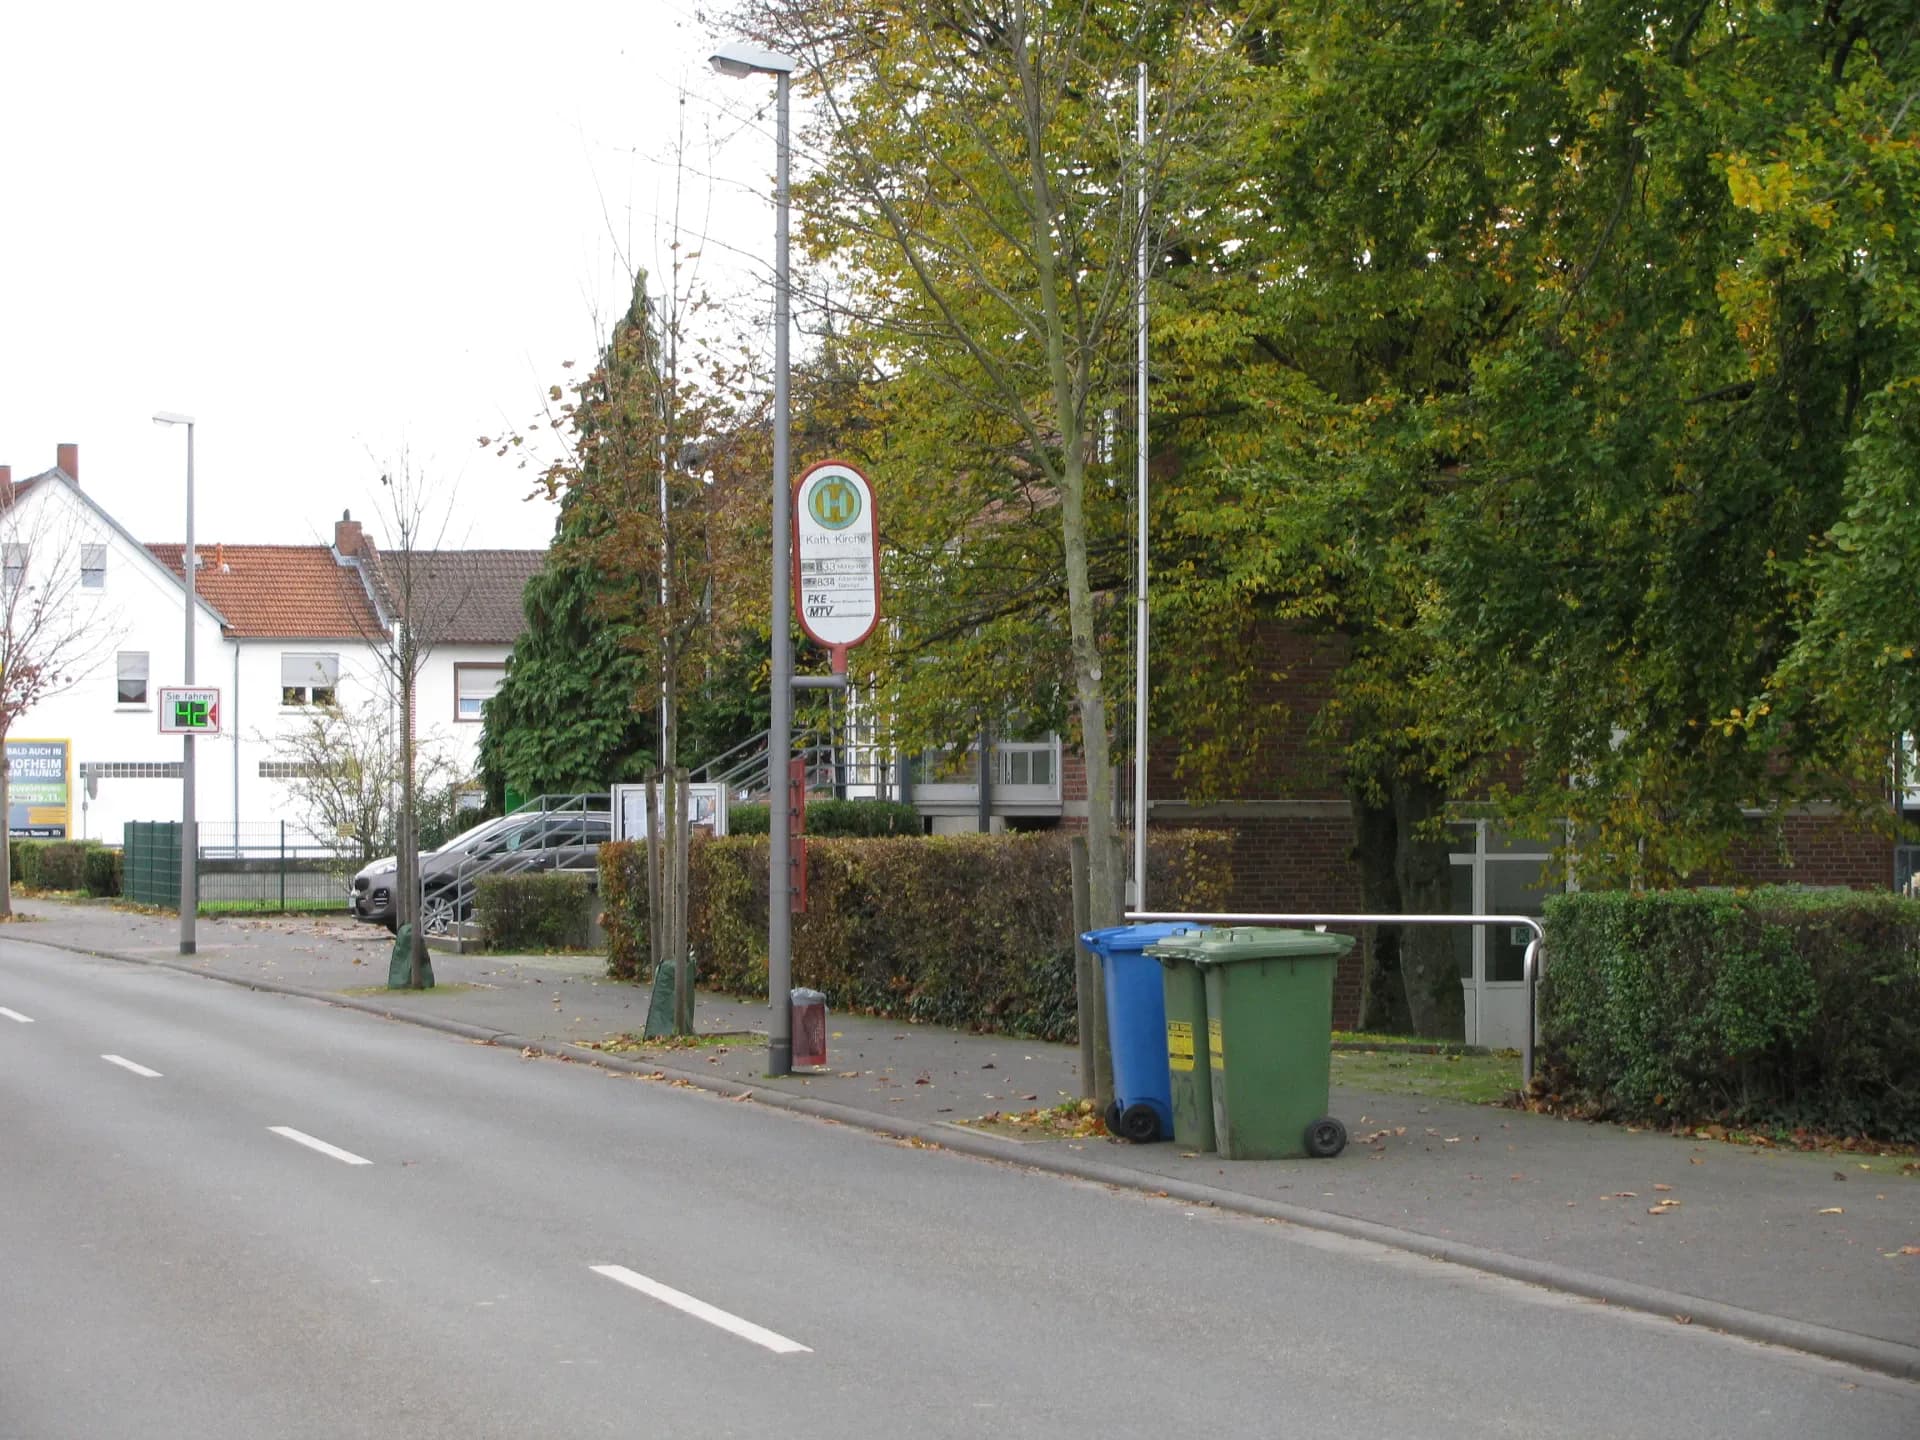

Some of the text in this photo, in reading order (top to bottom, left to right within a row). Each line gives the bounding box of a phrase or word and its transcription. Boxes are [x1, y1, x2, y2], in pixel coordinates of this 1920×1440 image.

[823, 488, 847, 518] H
[808, 594, 828, 605] FKE
[809, 606, 834, 617] MTV
[167, 692, 213, 701] Sie fahren
[176, 700, 208, 727] 42
[29, 747, 51, 755] AUCH
[53, 747, 62, 755] IN
[24, 768, 62, 777] TAUNUS
